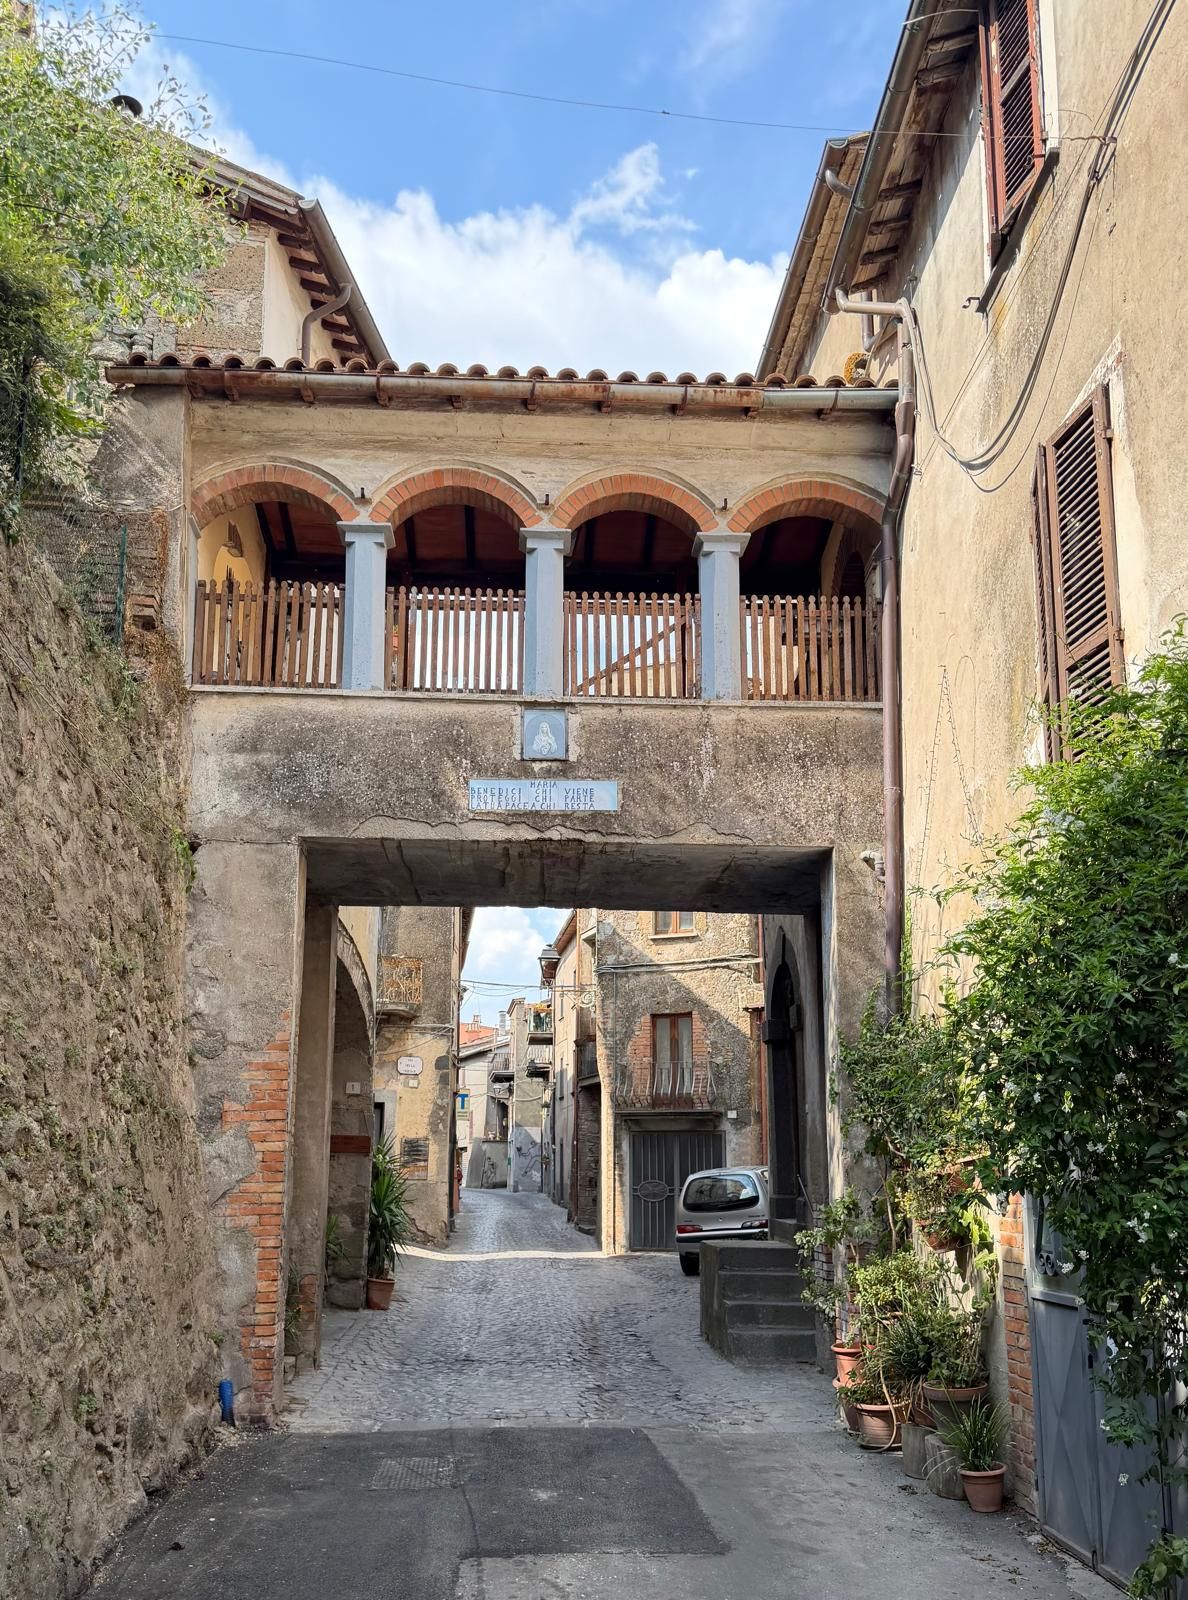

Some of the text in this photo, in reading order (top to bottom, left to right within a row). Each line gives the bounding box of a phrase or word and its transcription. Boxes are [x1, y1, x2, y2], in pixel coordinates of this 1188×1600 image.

[530, 781, 558, 789] MARIA
[470, 787, 522, 795] BENEDICI
[458, 1093, 469, 1110] T
